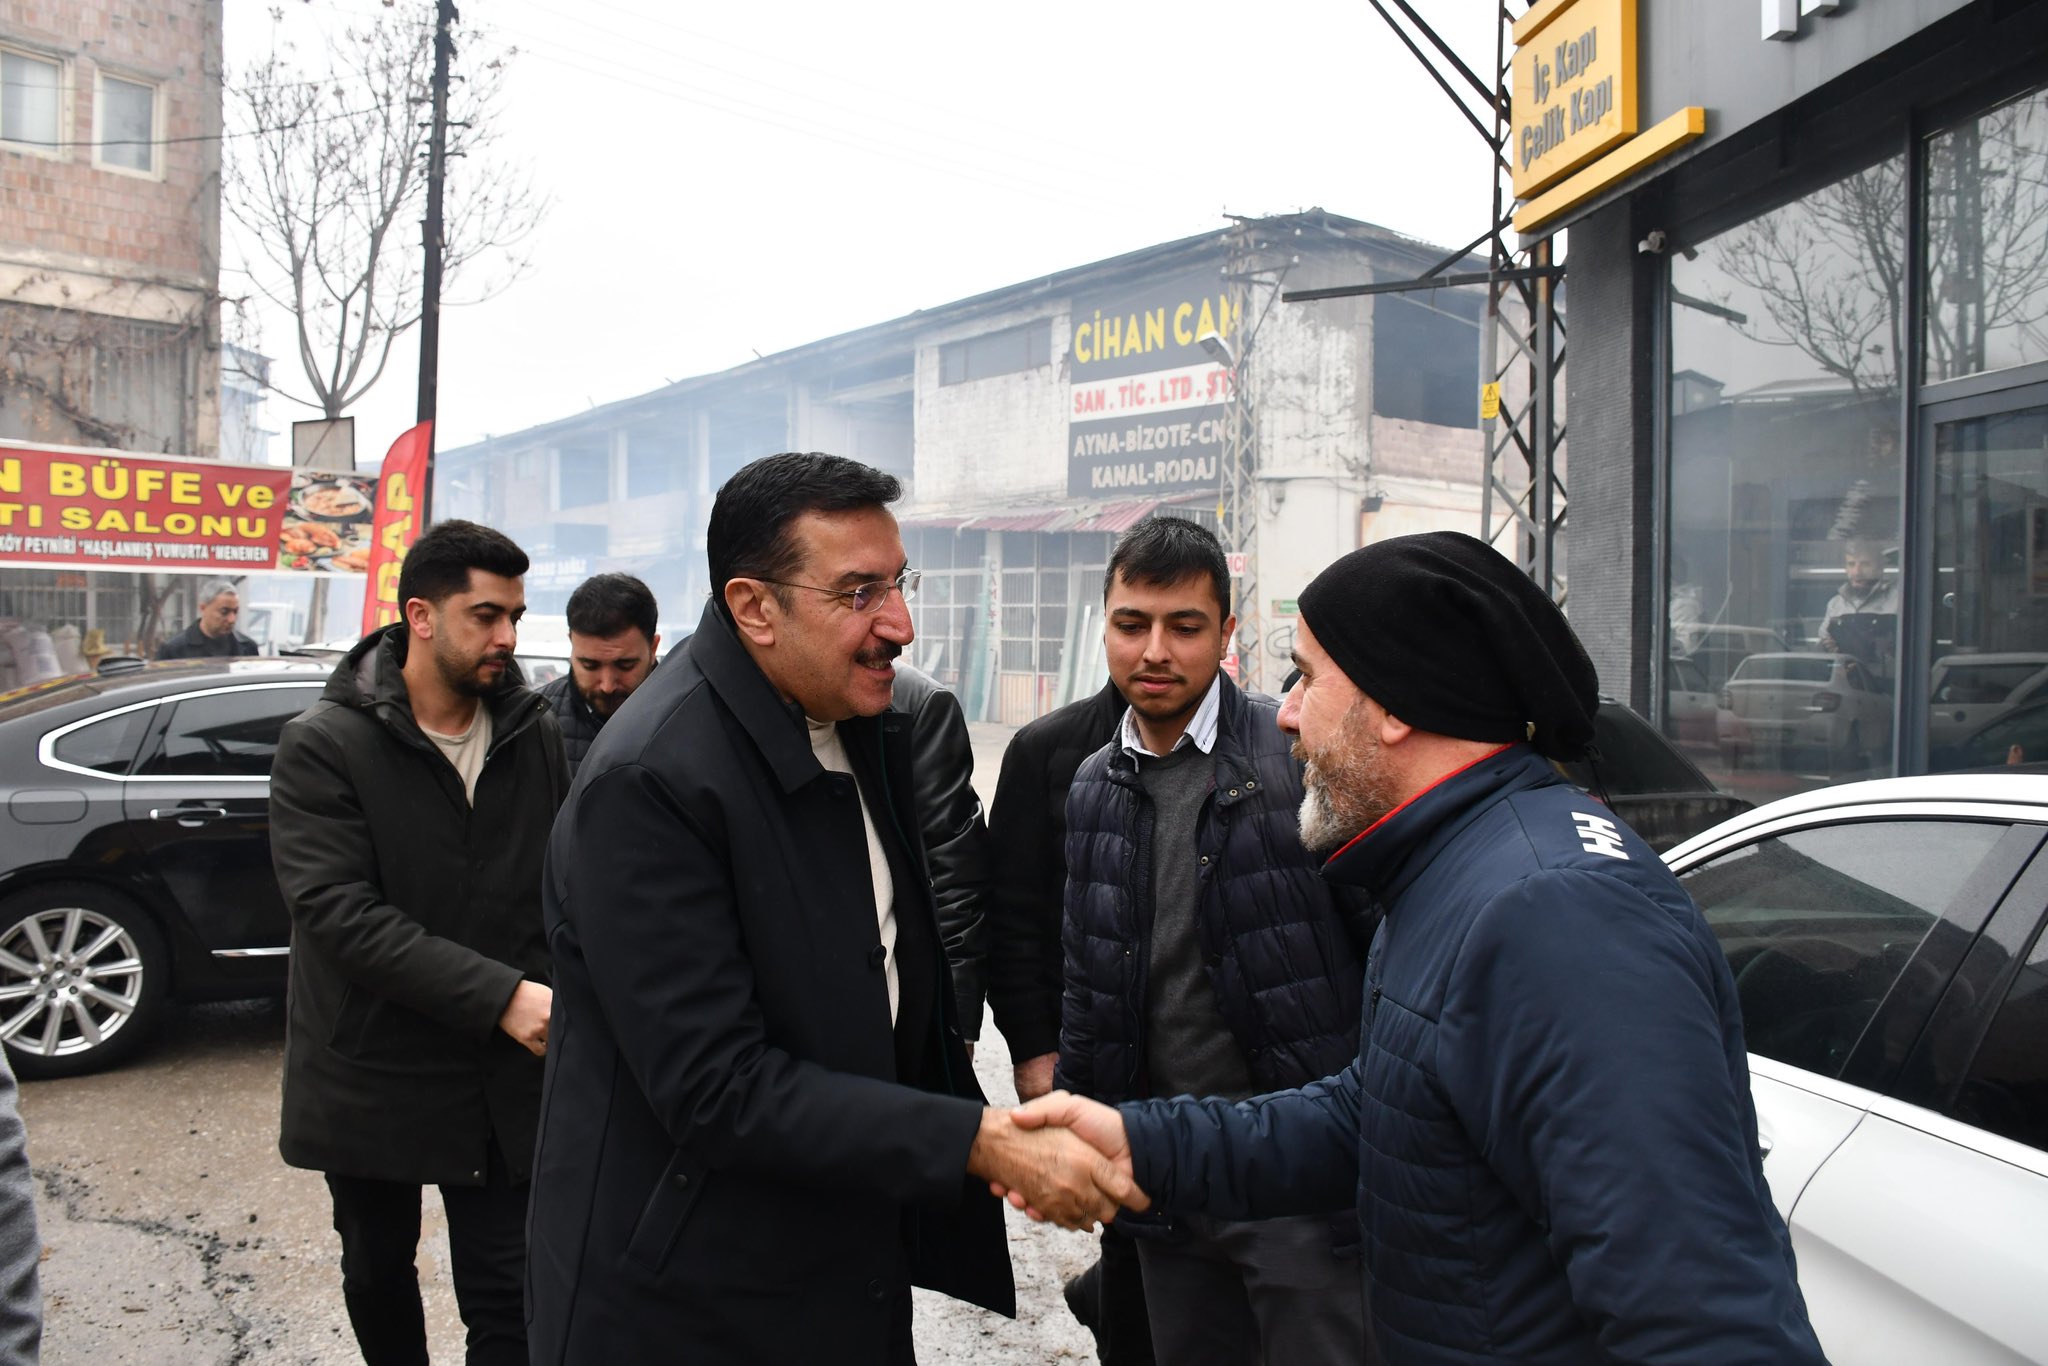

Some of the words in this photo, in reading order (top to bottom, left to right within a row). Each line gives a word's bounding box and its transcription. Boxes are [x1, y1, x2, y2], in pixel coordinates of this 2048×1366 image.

[1532, 54, 1550, 105] İç
[1555, 26, 1598, 89] Kapı
[1519, 108, 1566, 173] Çelik
[1570, 75, 1613, 136] Kapı
[1074, 306, 1165, 364] CİHAN
[49, 459, 202, 506] BÜFE
[216, 482, 275, 510] ve
[1091, 456, 1217, 489] KANAL-RODAJ
[60, 507, 268, 539] SALONU
